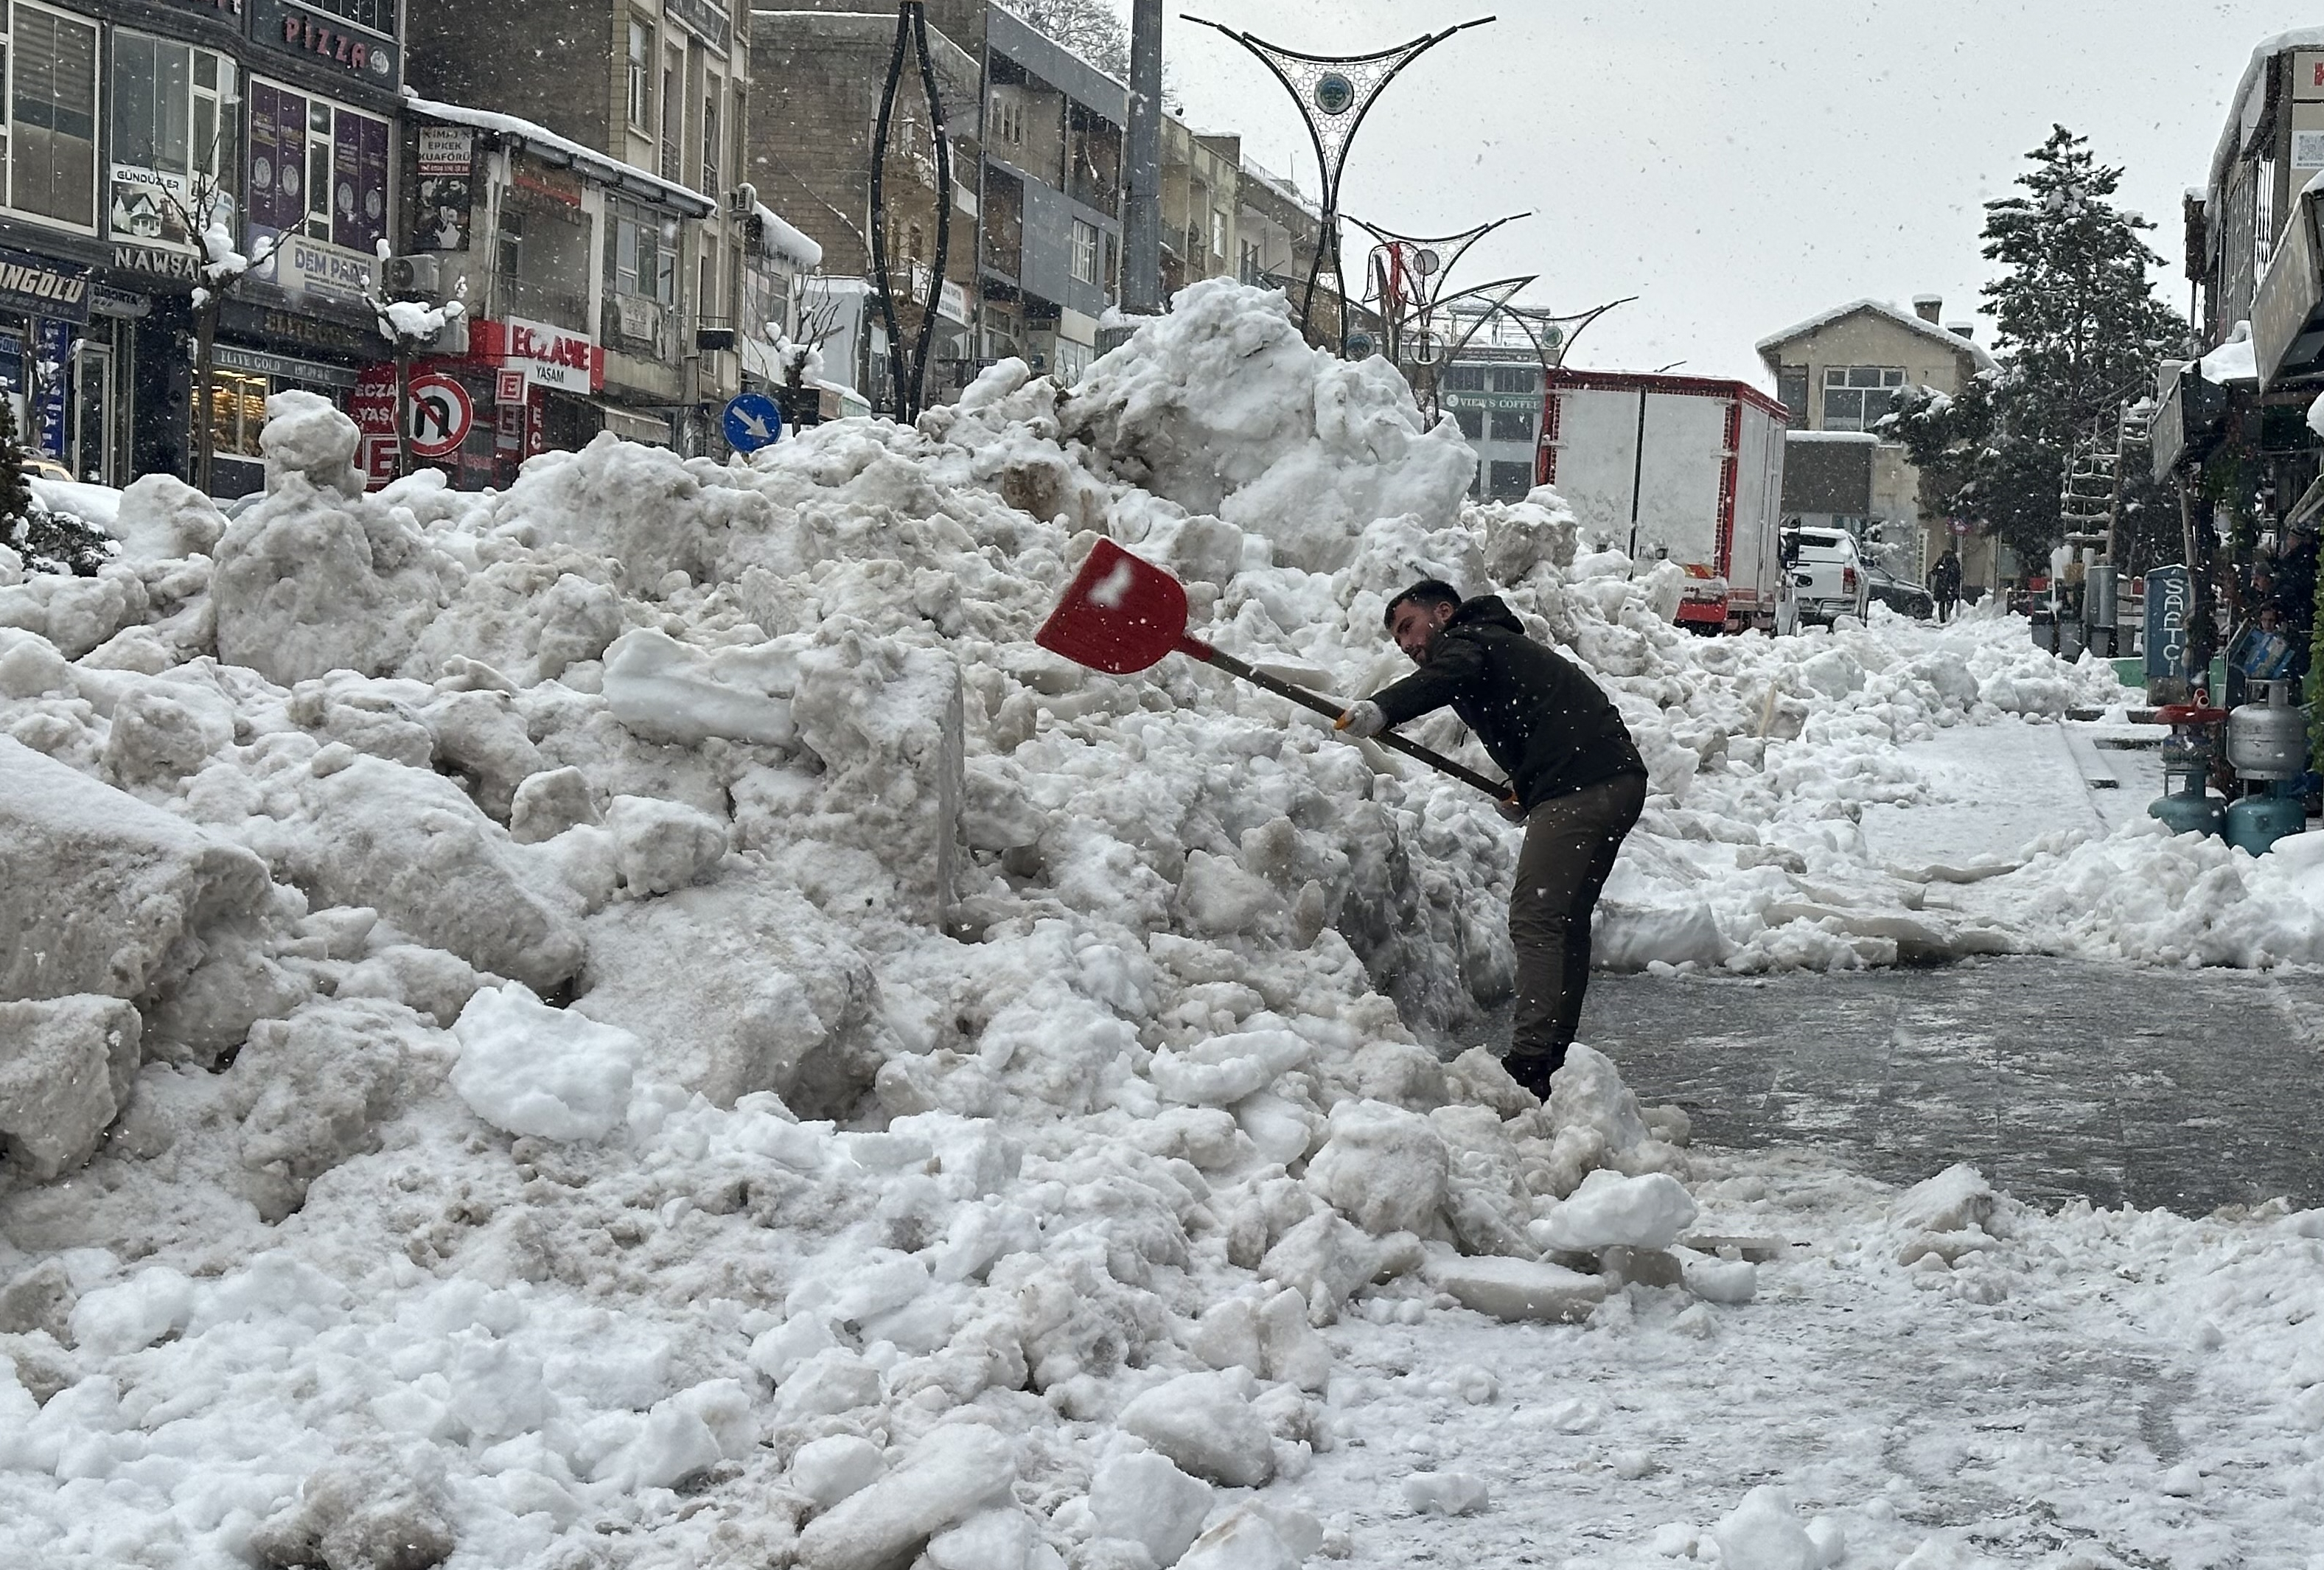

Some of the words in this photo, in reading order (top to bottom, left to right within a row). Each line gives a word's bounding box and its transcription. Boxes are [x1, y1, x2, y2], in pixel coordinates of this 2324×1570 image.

[115, 247, 201, 282] NAWŞA
[295, 247, 327, 276] DEM
[254, 356, 280, 371] GOLD
[536, 365, 565, 383] YAŞAM
[358, 407, 393, 425] YAŞ
